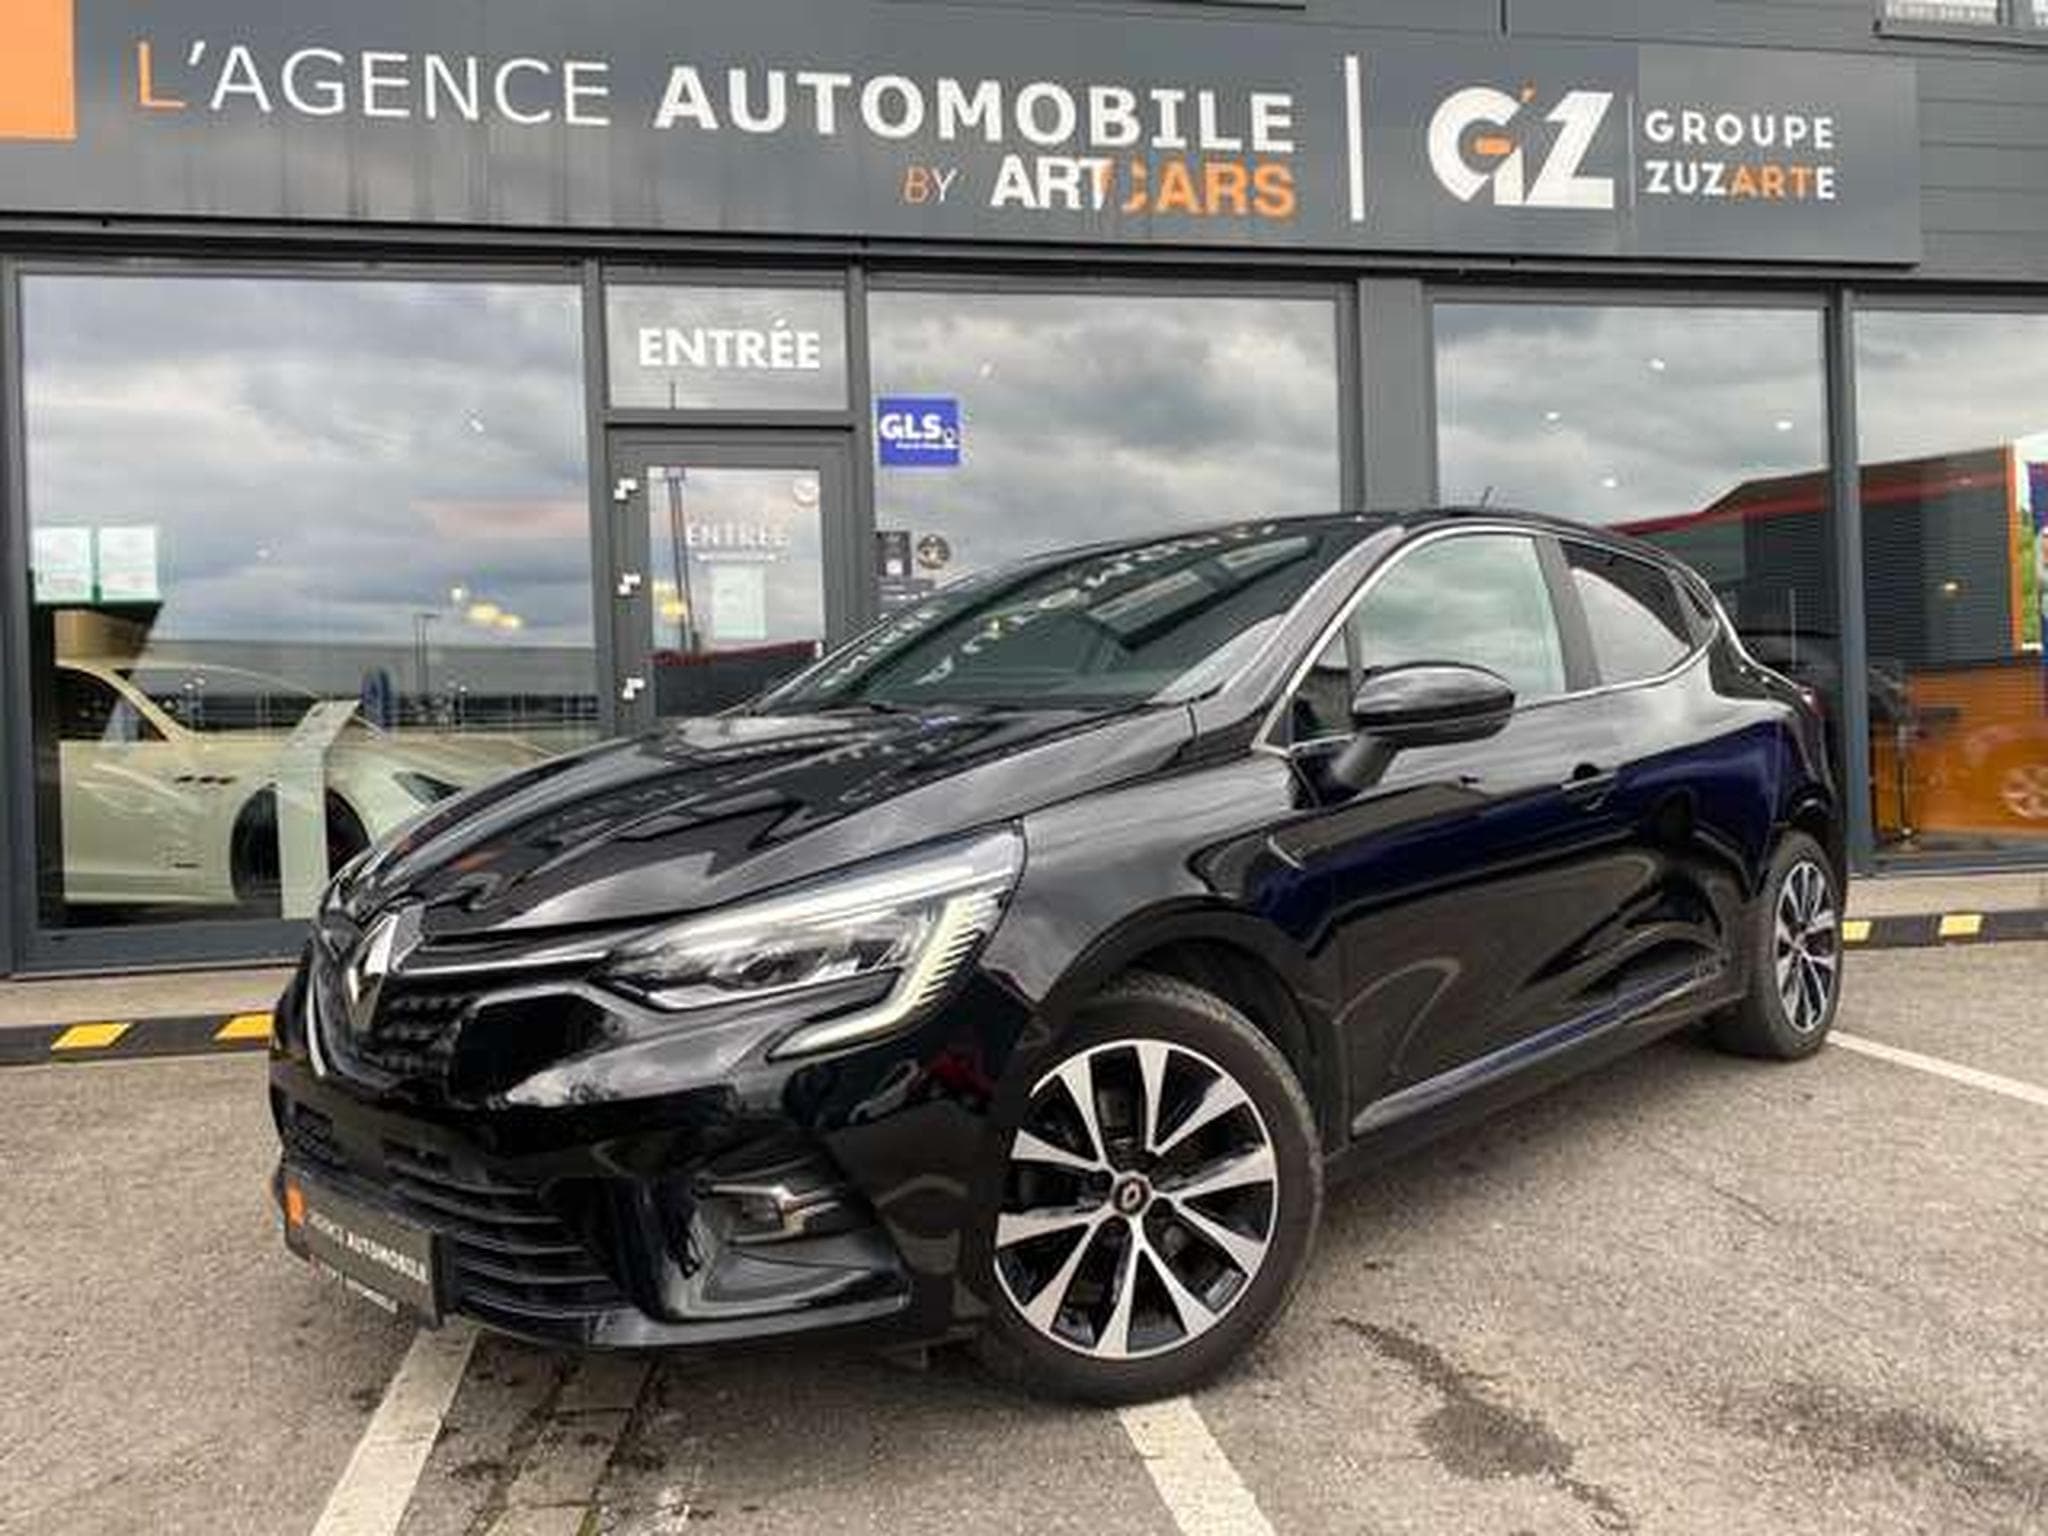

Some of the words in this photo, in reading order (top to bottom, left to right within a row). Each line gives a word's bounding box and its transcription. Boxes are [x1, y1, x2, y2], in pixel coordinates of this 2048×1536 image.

[137, 40, 612, 127] L'AGENCE
[653, 65, 1296, 153] AUTOMOBILE
[1644, 109, 1836, 150] GROUPE
[903, 166, 957, 202] BY
[1644, 159, 1838, 202] ZUZARTE
[638, 319, 822, 370] ENTRÉE
[880, 412, 942, 439] GLS
